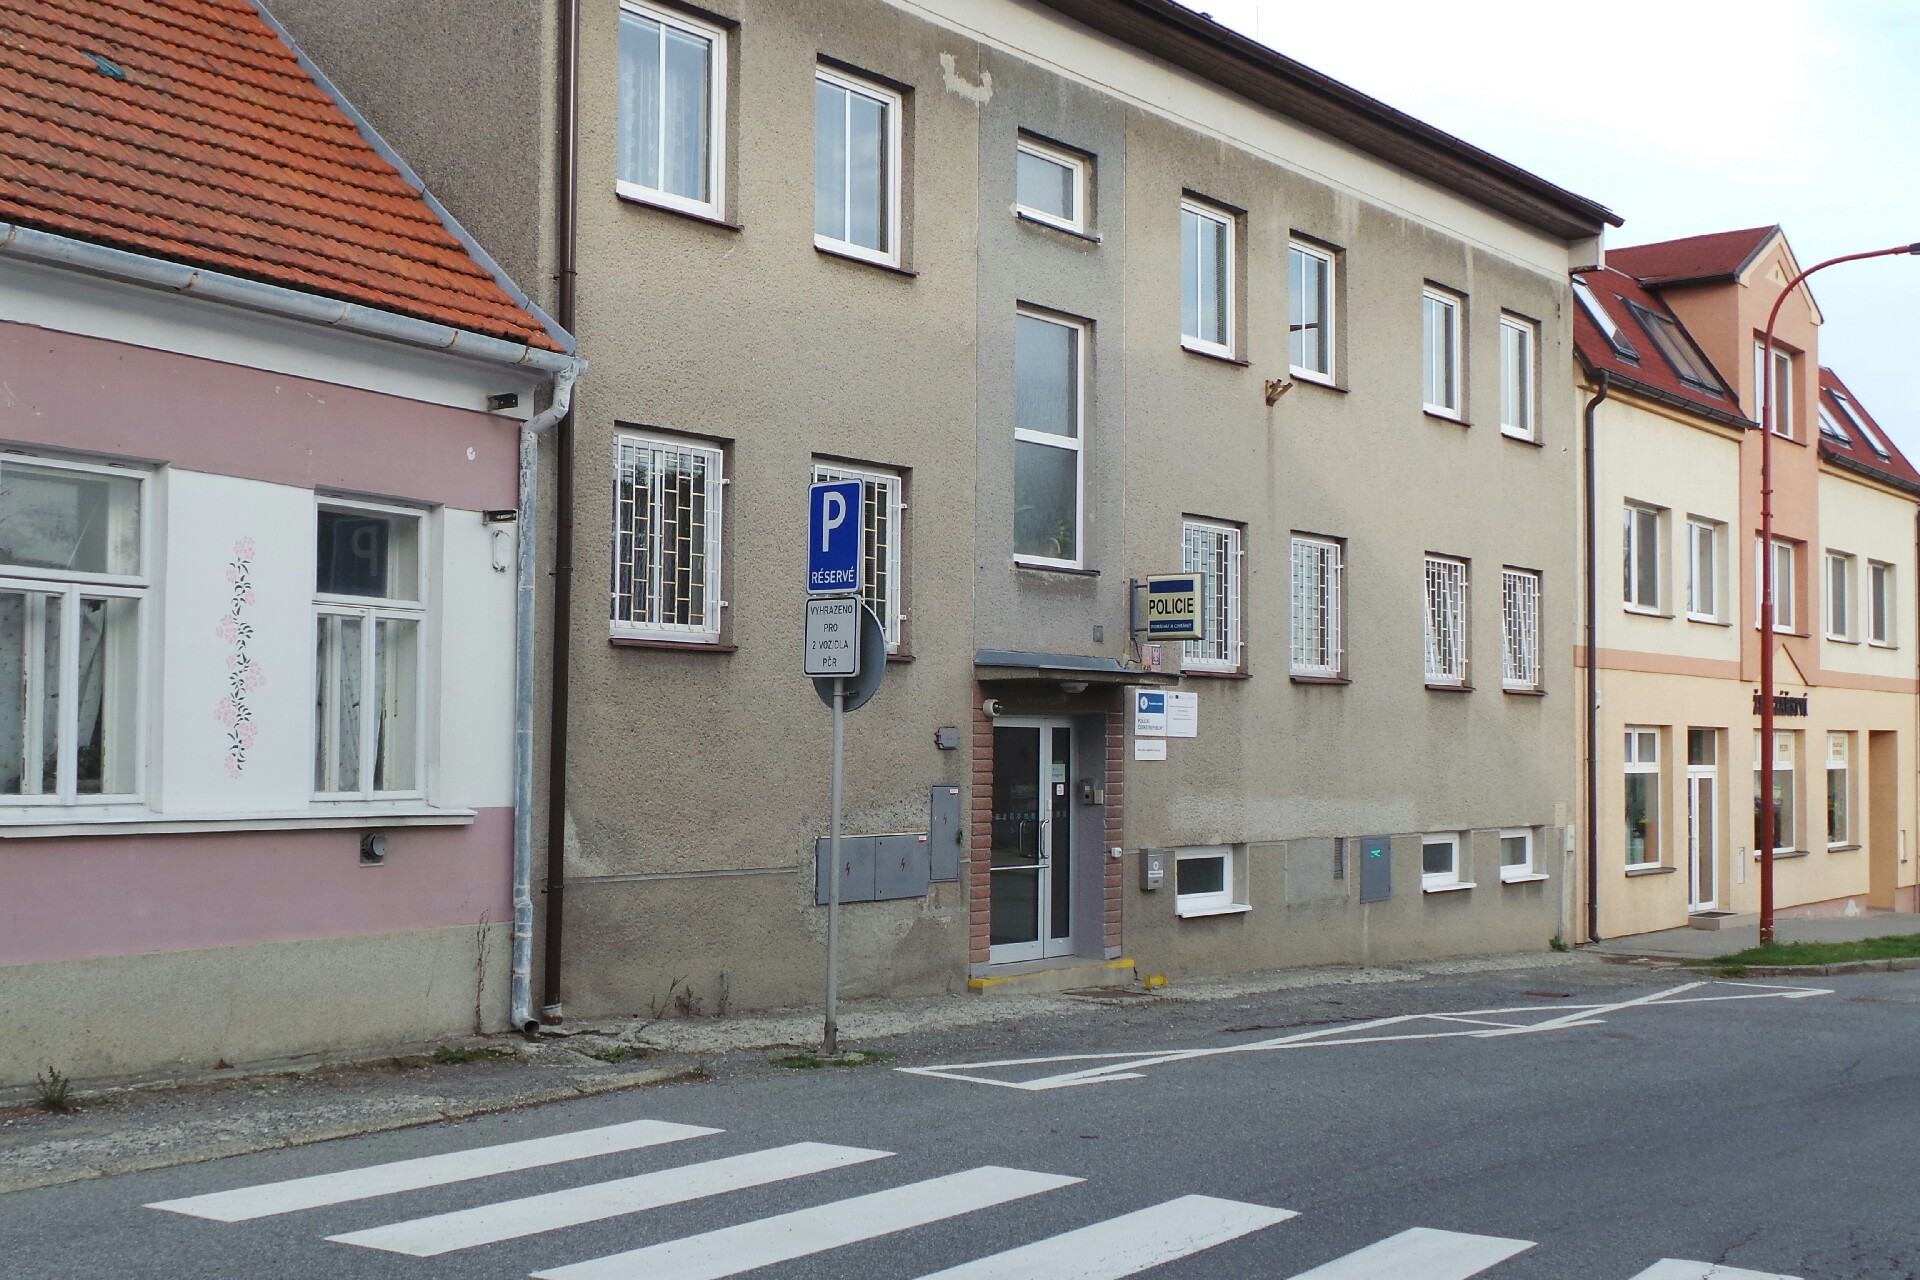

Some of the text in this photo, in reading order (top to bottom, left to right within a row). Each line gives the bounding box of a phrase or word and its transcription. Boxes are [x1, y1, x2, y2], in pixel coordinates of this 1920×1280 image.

[822, 490, 846, 552] P
[811, 566, 855, 584] RÉSERVÉ
[810, 604, 853, 615] VYHRAZENO
[1149, 597, 1194, 615] POLICIE
[823, 623, 838, 632] PRO
[812, 640, 849, 649] 2 VOZIDLA
[822, 656, 837, 667] PČR
